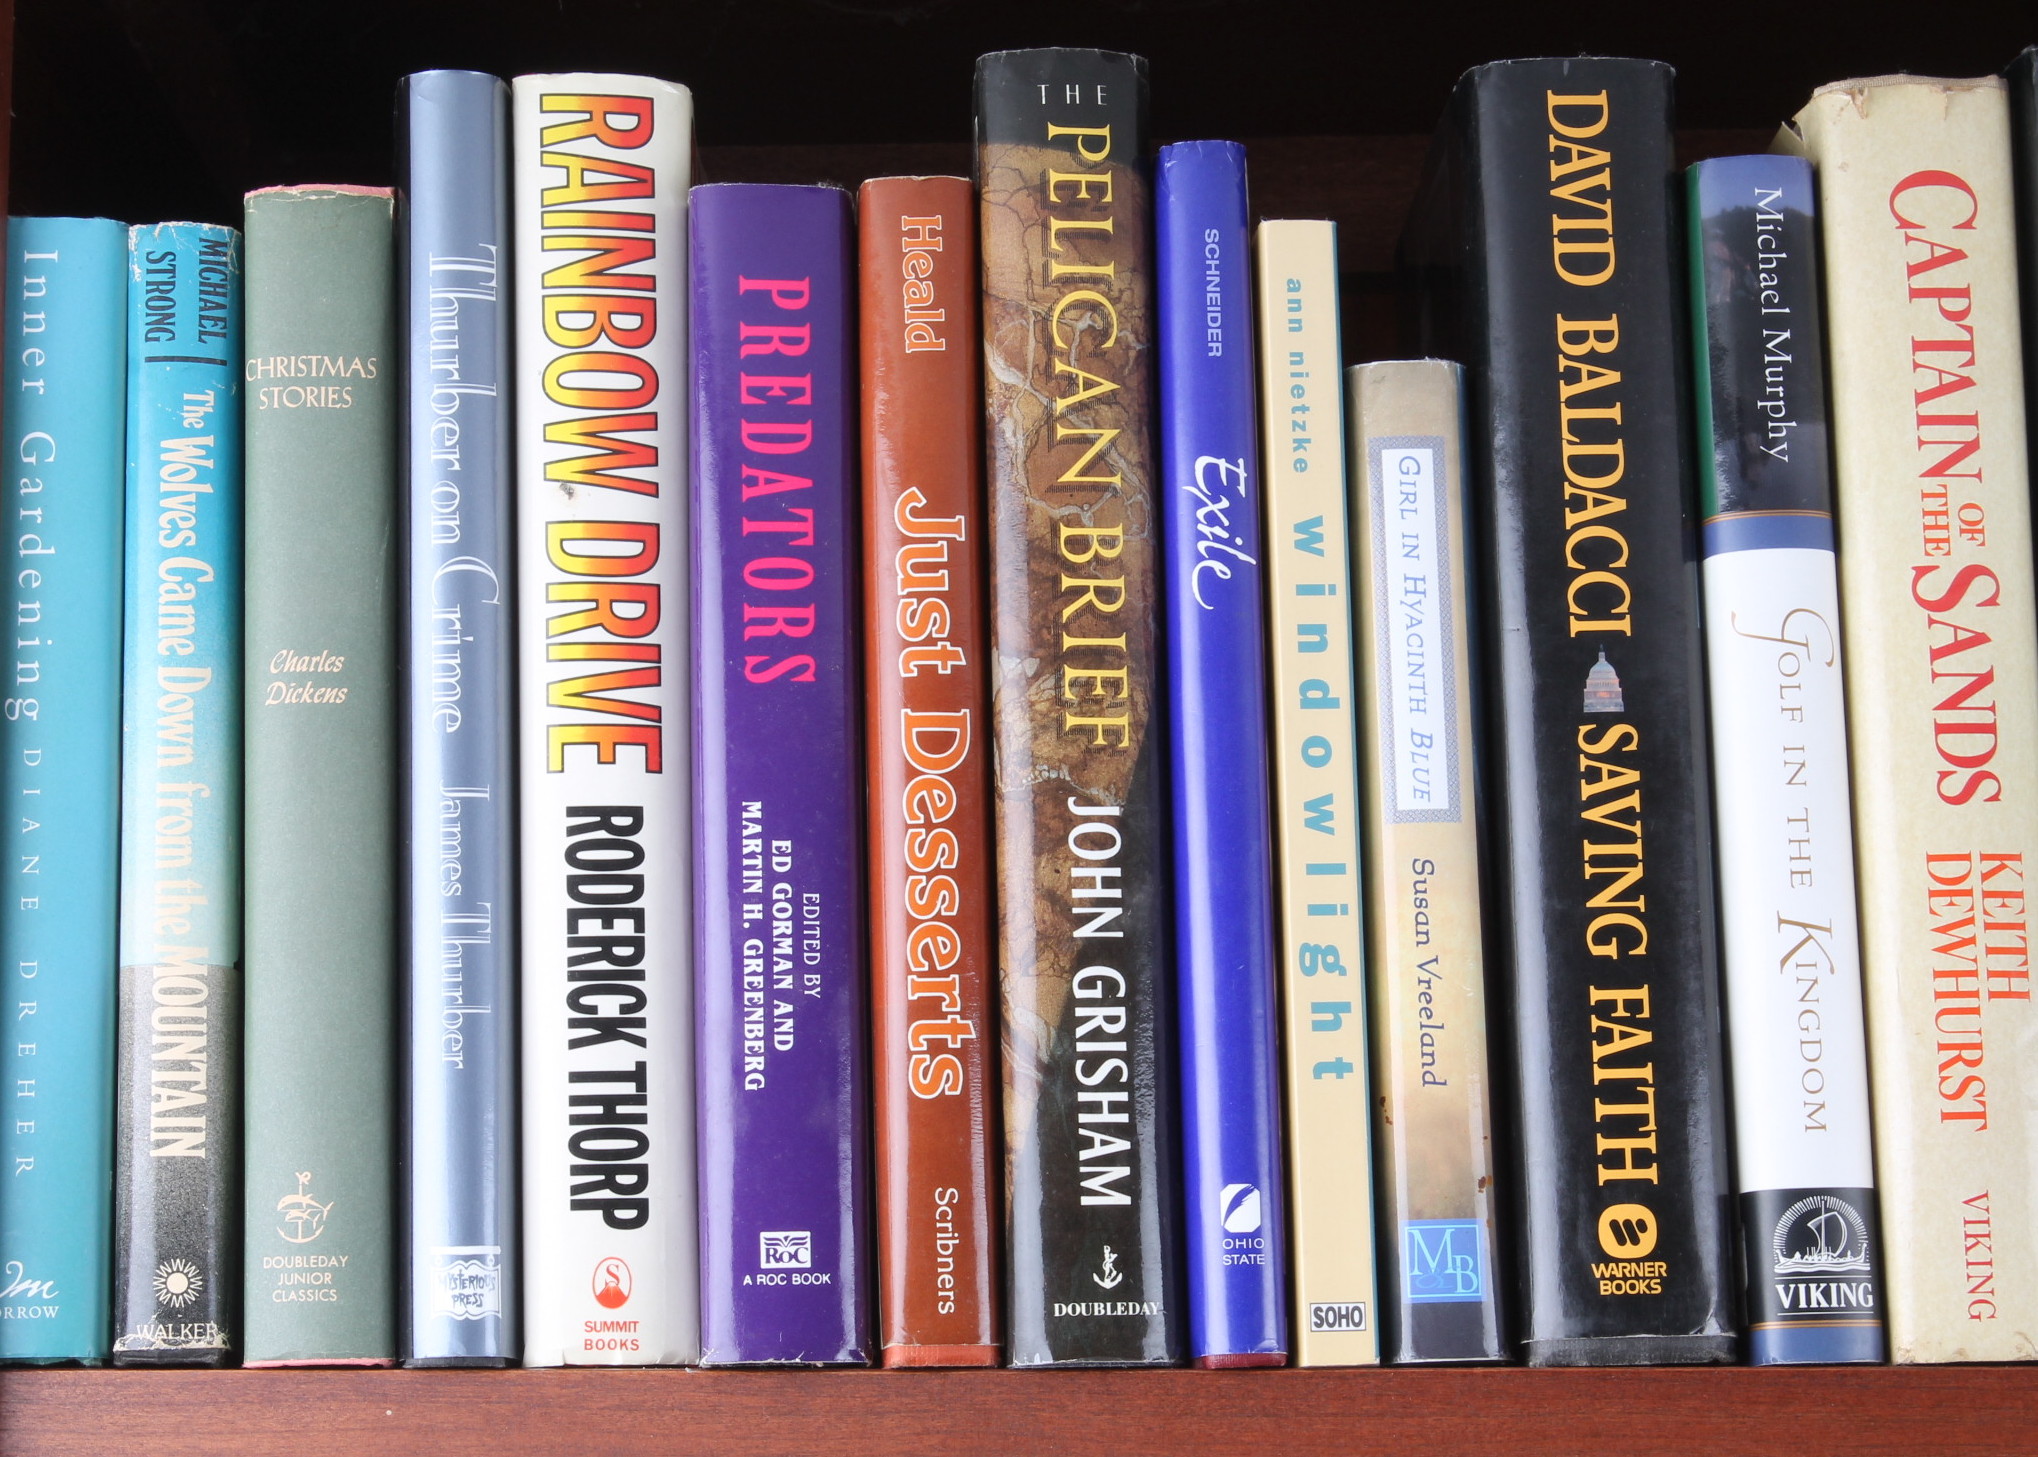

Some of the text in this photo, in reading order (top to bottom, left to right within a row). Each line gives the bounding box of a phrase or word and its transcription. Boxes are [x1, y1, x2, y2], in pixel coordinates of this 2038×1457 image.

[1037, 83, 1108, 107] THE
[144, 250, 177, 344] STRONG
[197, 237, 229, 344] MICHAEL
[901, 213, 947, 354] Heald
[1204, 227, 1223, 359] SCHNEIDER
[1753, 186, 1797, 464] Michael Murphy
[246, 356, 378, 382] CHRISTMAS
[258, 385, 353, 410] STORIES
[1285, 277, 1312, 475] ann nietzke
[1546, 88, 1632, 638] DAVID BALDACCI
[5, 249, 59, 722] Inner Gardening
[428, 243, 500, 734] Thurber on Crime
[540, 93, 663, 774] RAINBOW DRIVE
[738, 274, 817, 685] PREDATORS
[1046, 121, 1132, 751] PELICAN BRIEF
[1888, 169, 2003, 807] CAPTAIN OF THE SANDS
[1183, 454, 1256, 611] Exile
[265, 681, 347, 707] Dickens
[269, 649, 345, 675] Charles
[1397, 454, 1432, 803] GIRL IN HYACINTH BLUE
[149, 390, 215, 1160] The Wolves Came Down from the MOUNTAIN
[893, 486, 977, 1101] Just Desserts
[1292, 514, 1354, 1081] windowlight
[440, 783, 492, 1070] James Thurber
[1731, 607, 1835, 1134] GOLF IN THE KINGDOM
[1978, 850, 2032, 1004] KEITH
[15, 748, 42, 1177] DIANE DREHER
[741, 800, 766, 1092] MARTIN H. GREENBERG
[771, 839, 795, 1053] ED GORMAN AND
[802, 892, 821, 1000] EDITED BY
[1067, 796, 1132, 1207] JOHN GRISHAM
[1410, 857, 1448, 1088] Susan Vreeland
[1577, 723, 1658, 1188] SAVING FAITH
[1924, 850, 1990, 1132] DEWHURST
[564, 804, 650, 1231] RODERICK THORP
[262, 1256, 349, 1270] DOUBLEDAY
[272, 1289, 338, 1303] CLASSICS
[277, 1272, 333, 1286] JUNIOR
[437, 1268, 496, 1292] YSTERIOUS
[451, 1292, 485, 1309] PRESS
[743, 1272, 831, 1286] A ROC BOOK
[933, 1187, 958, 1316] Scribners
[1053, 1301, 1160, 1317] DOUBLEDAY
[1222, 1237, 1266, 1250] OHIO
[1222, 1254, 1266, 1266] STATE
[1591, 1261, 1667, 1279] WARNER
[1599, 1279, 1662, 1295] BOOKS
[1775, 1282, 1875, 1309] VIKING
[1959, 1189, 1998, 1323] VIKING
[0, 1305, 60, 1320] RROW
[136, 1322, 218, 1342] WALKER
[583, 1338, 640, 1352] BOOKS
[584, 1320, 640, 1334] SUMMIT
[1312, 1306, 1364, 1330] SOHO
